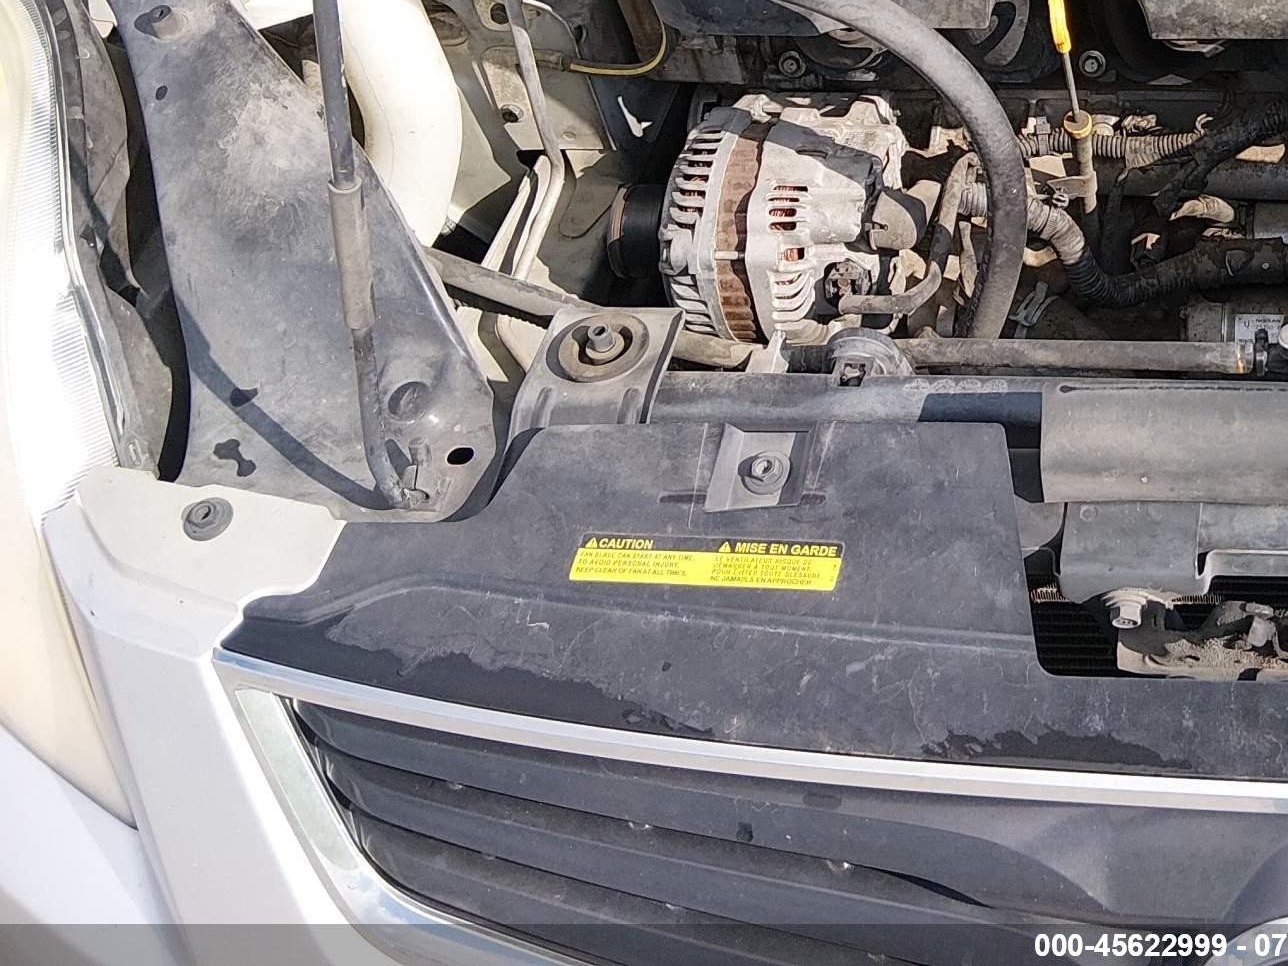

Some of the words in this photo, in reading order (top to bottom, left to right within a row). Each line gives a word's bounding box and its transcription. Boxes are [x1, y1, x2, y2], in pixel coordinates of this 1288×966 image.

[599, 538, 654, 550] CAUTION
[734, 542, 768, 554] MISE
[769, 543, 788, 554] EN
[790, 544, 838, 557] GARDE
